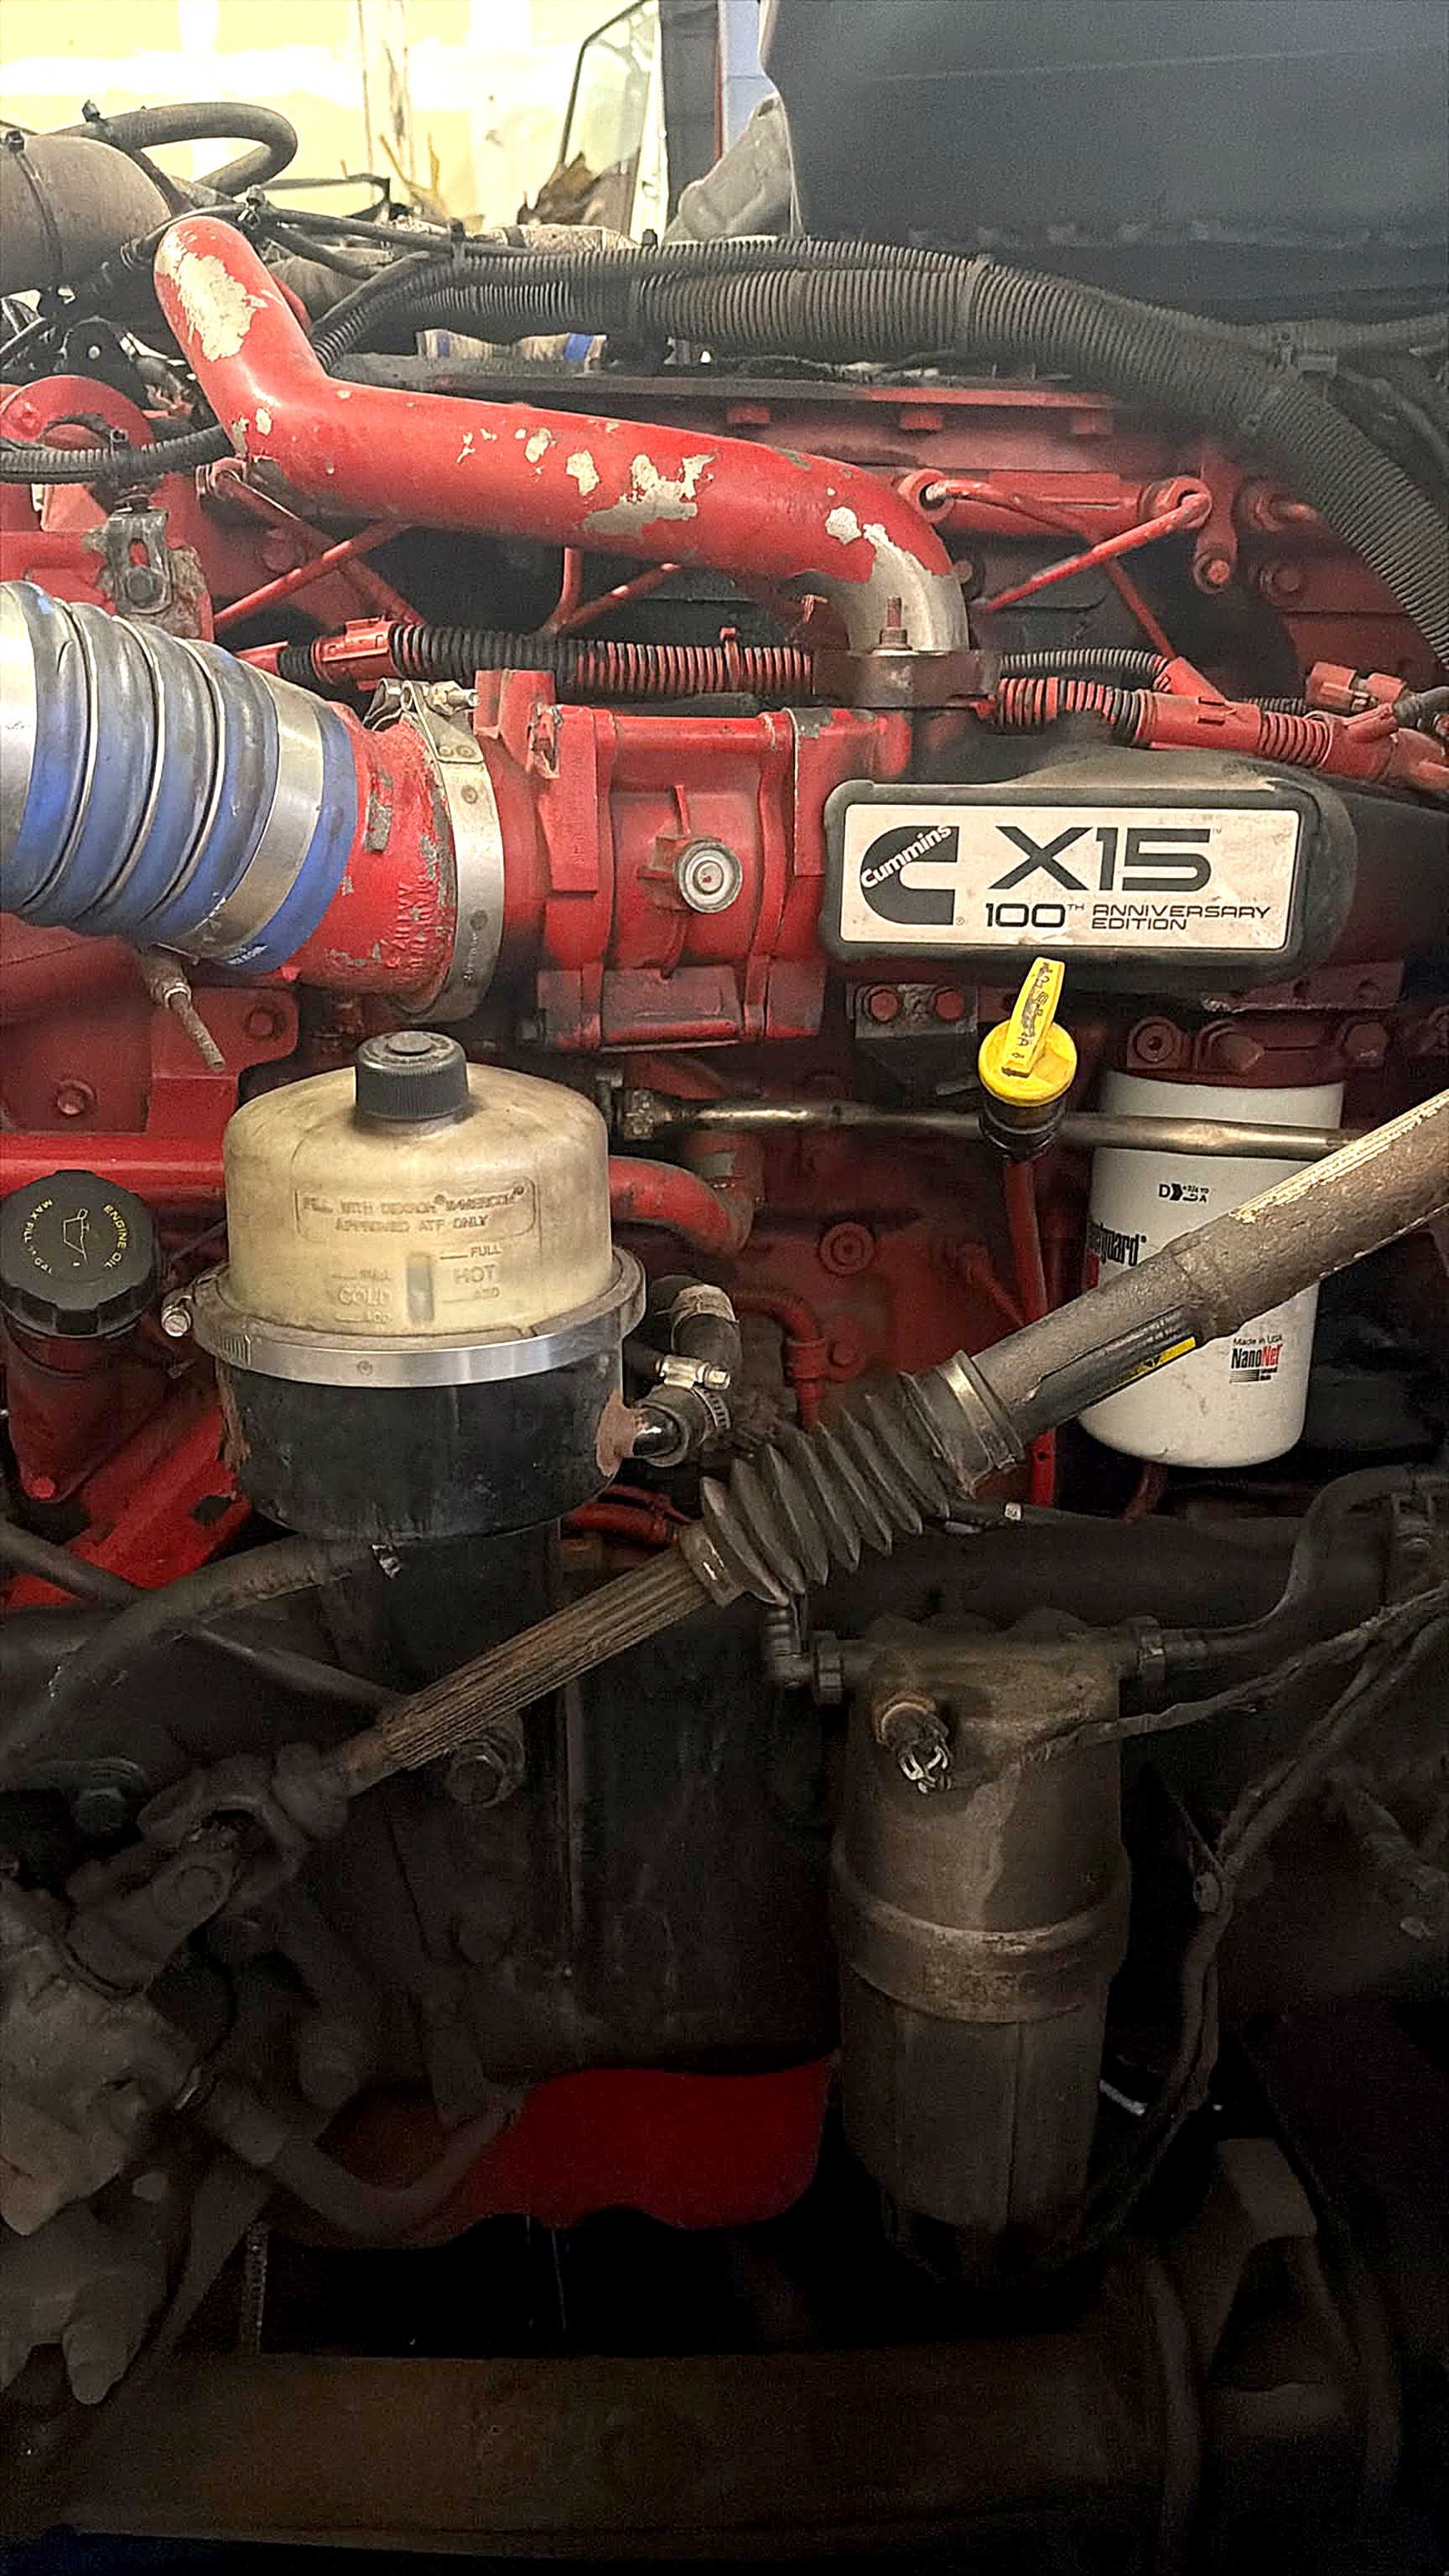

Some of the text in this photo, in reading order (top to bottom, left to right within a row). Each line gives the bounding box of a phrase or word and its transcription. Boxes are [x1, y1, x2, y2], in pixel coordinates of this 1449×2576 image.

[860, 825, 953, 888] Cummins
[987, 826, 1212, 892] X15
[1092, 904, 1271, 919] ANNIVERSARY
[1091, 917, 1187, 930] EDITION
[30, 1199, 54, 1221] MAX
[453, 1214, 489, 1229] ONLY
[23, 1222, 34, 1244] FILL
[103, 1204, 127, 1269] ENGINE OIL
[470, 1245, 502, 1258] FULL
[454, 1265, 496, 1284] HOT
[338, 1286, 392, 1306] COLD
